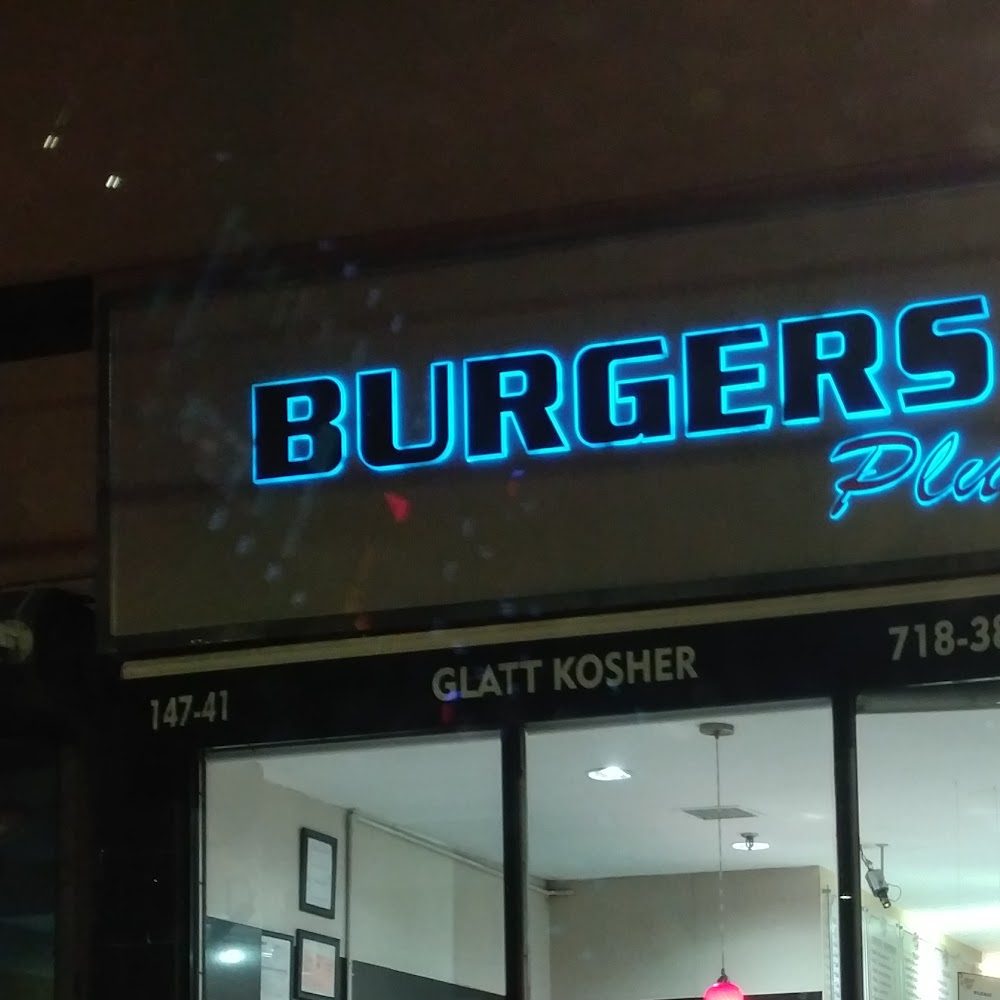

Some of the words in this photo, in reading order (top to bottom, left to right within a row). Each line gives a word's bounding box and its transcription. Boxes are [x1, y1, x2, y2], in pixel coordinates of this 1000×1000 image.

[251, 294, 996, 485] BURGERS
[432, 659, 543, 701] GLATT
[552, 645, 699, 691] KOSHER
[150, 690, 228, 730] 147-41
